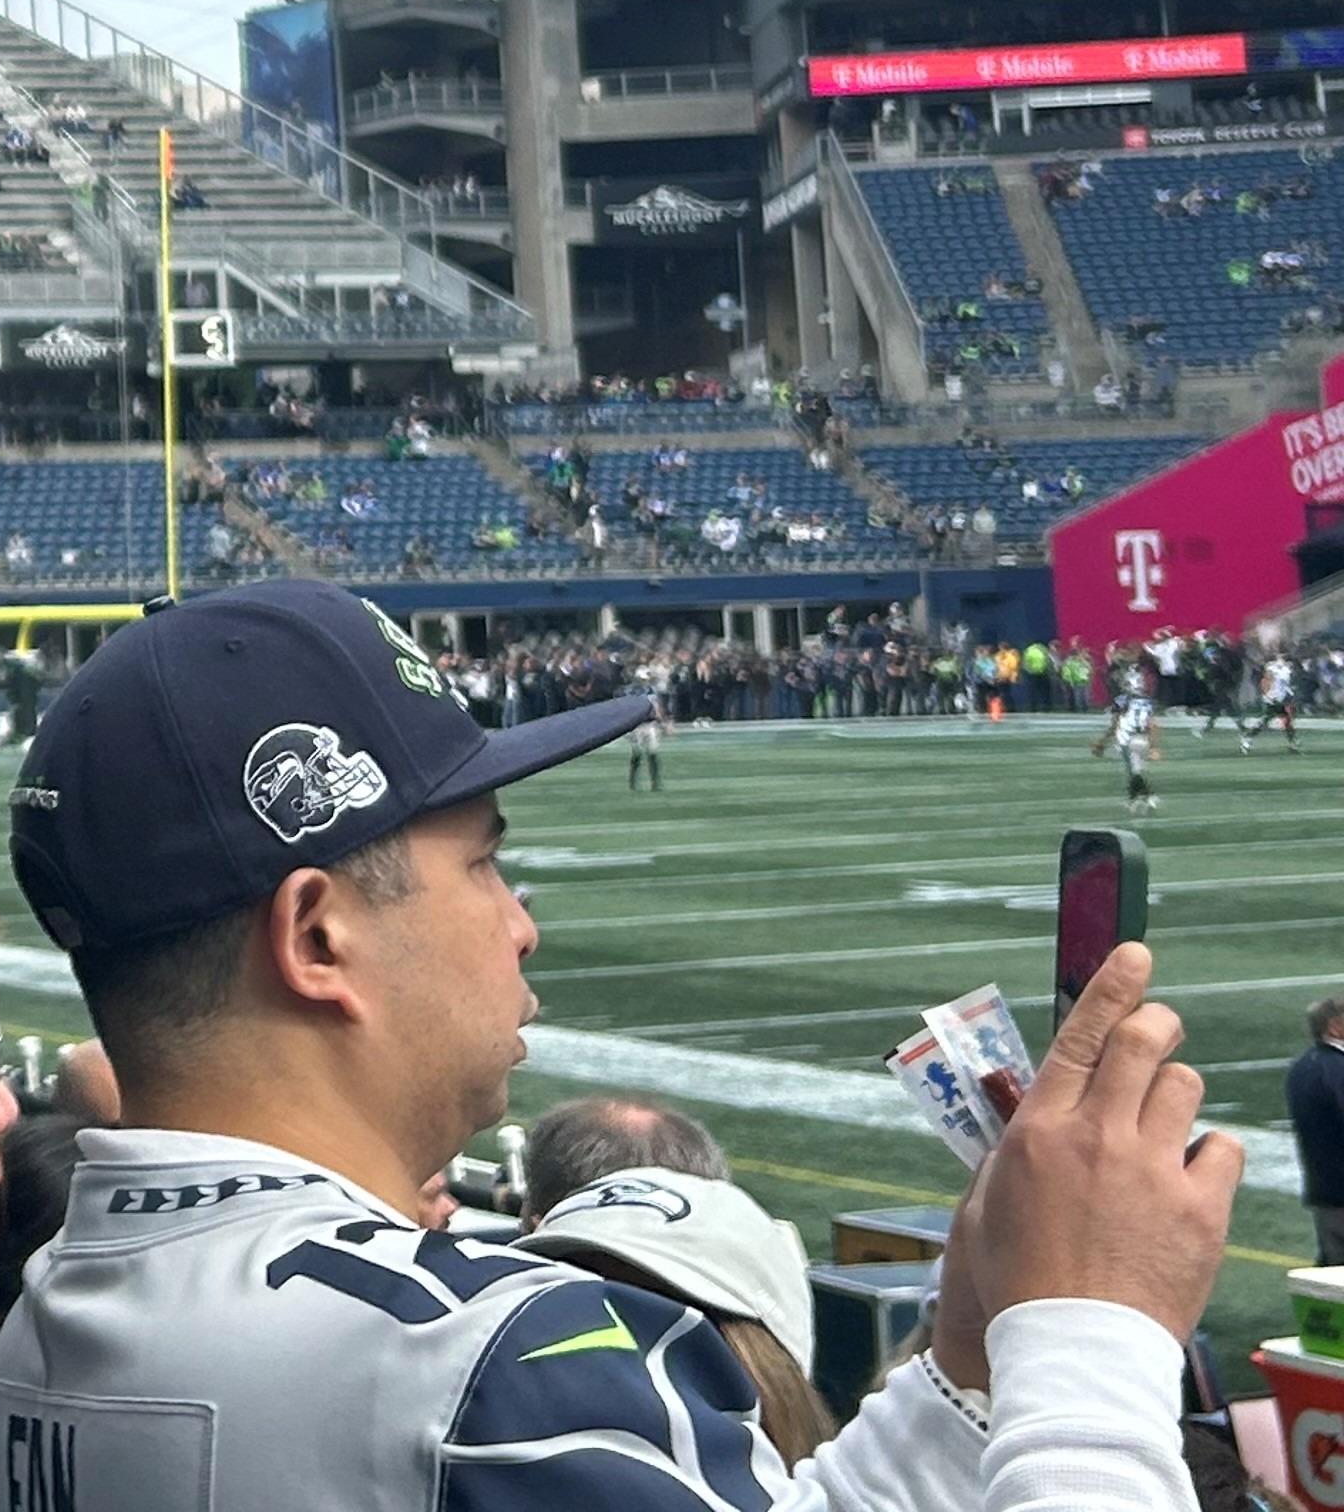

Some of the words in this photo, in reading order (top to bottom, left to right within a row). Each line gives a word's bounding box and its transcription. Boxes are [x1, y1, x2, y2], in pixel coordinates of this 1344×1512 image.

[1001, 51, 1075, 80] Mobile
[1146, 43, 1222, 72] Mobile
[856, 58, 928, 88] Mobile
